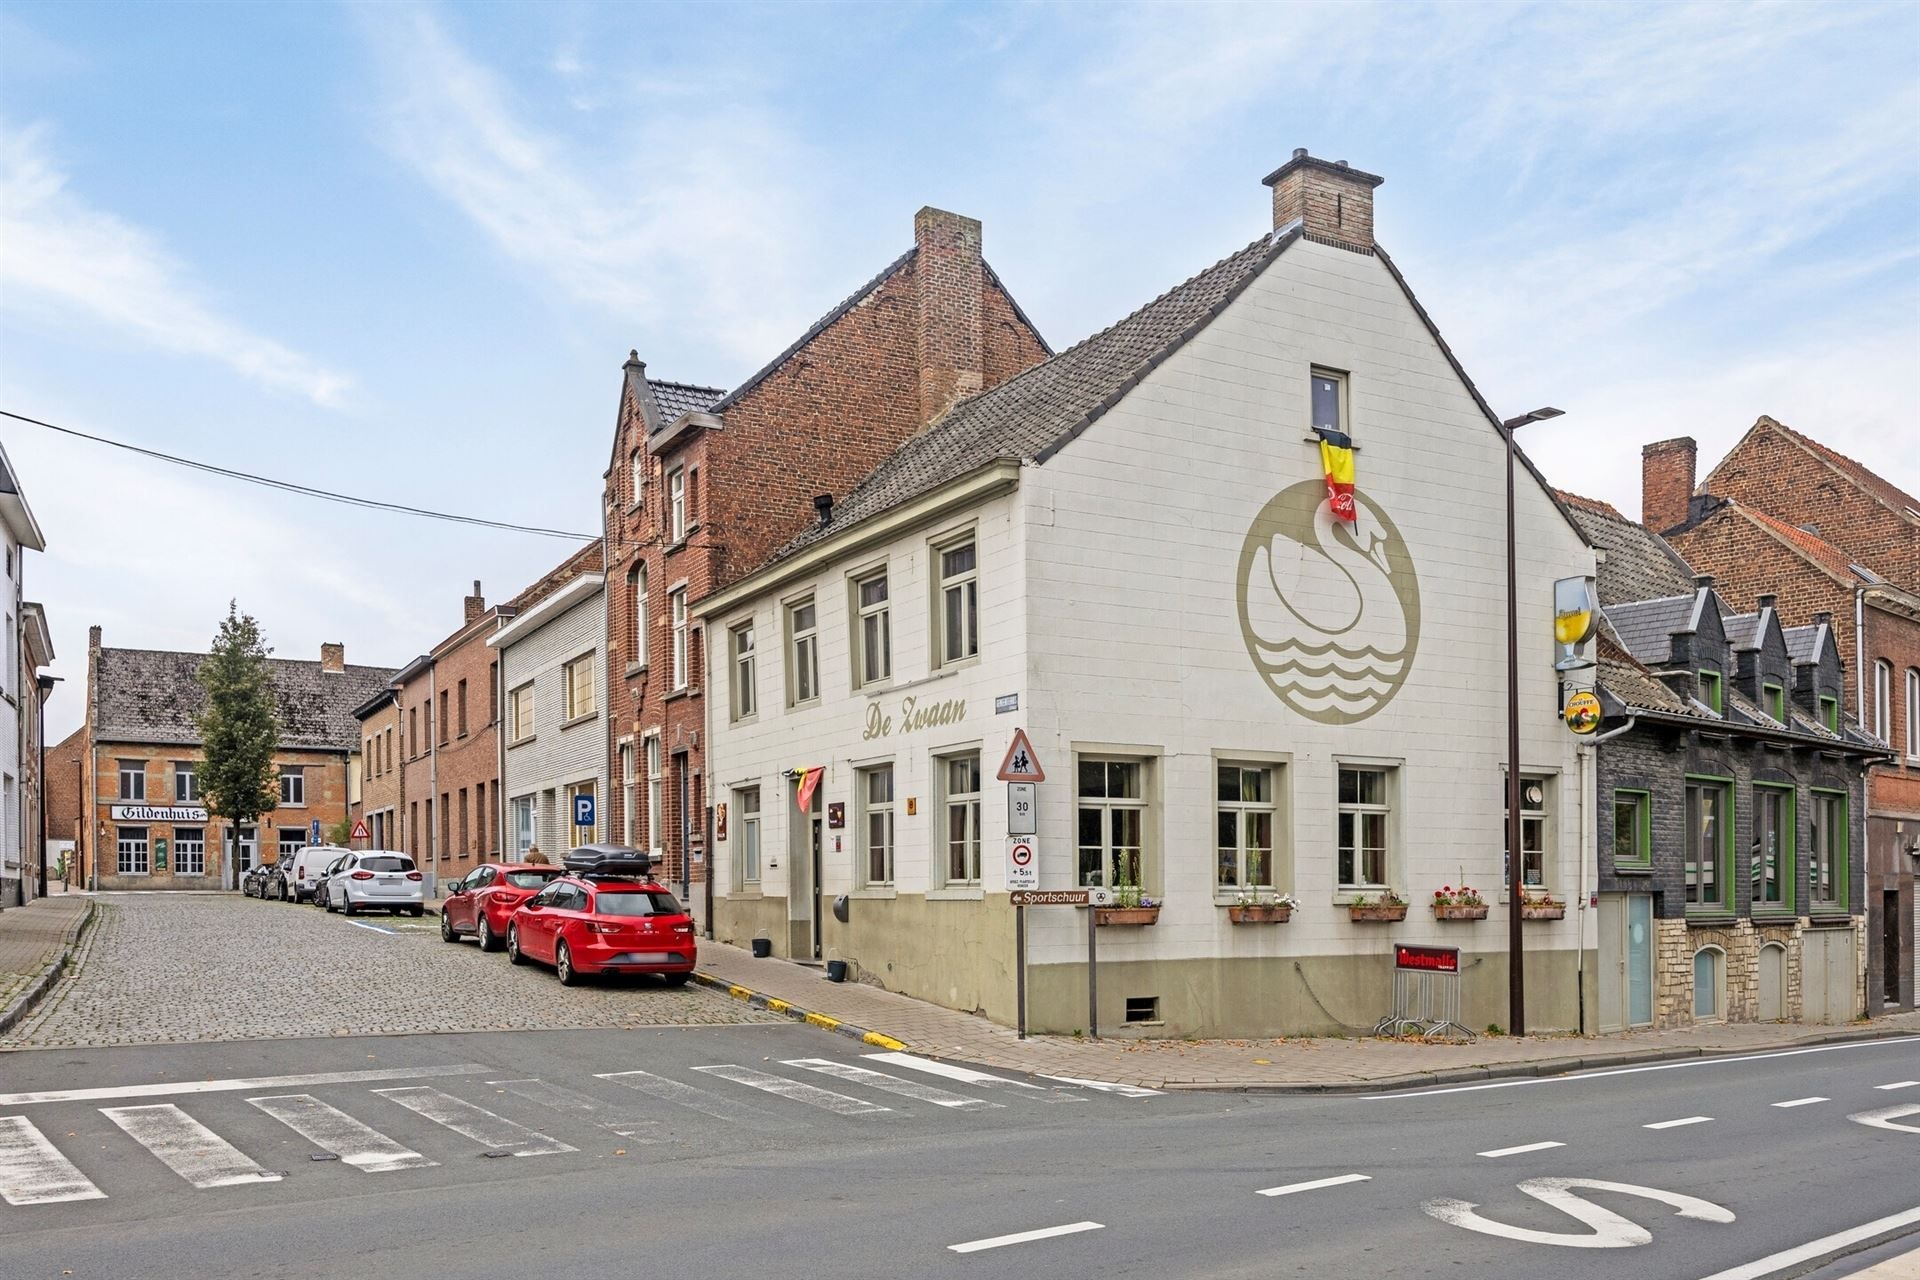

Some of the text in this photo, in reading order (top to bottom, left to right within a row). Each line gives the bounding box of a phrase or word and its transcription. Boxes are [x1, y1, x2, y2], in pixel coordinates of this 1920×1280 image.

[863, 701, 891, 740] De
[899, 696, 966, 733] Zwaan
[577, 799, 592, 821] P
[1016, 801, 1029, 811] 30
[121, 807, 199, 820] Gildenhuis
[1023, 892, 1086, 905] Sportschuur
[1398, 950, 1457, 966] Westmalle
